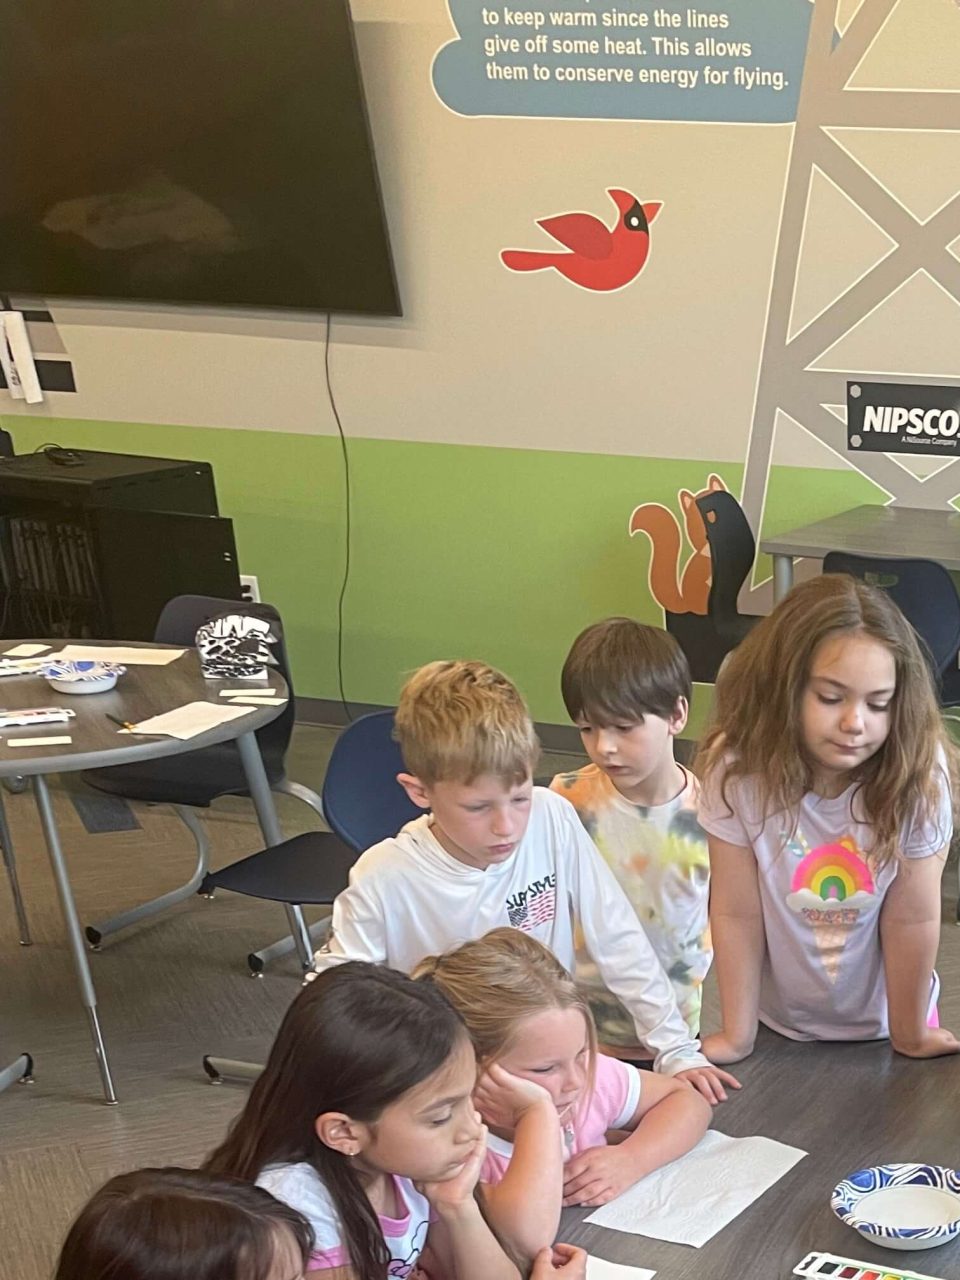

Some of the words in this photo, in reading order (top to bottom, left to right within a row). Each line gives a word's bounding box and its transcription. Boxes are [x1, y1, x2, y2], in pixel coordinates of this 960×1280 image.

[482, 8, 500, 25] to
[504, 8, 545, 30] keep
[549, 12, 597, 27] warm
[602, 9, 649, 27] since
[653, 9, 682, 28] the
[687, 9, 730, 29] lines
[484, 35, 521, 57] give
[525, 35, 548, 53] off
[552, 40, 600, 54] some
[604, 36, 647, 55] heat.
[651, 37, 690, 56] This
[695, 38, 752, 57] allows
[487, 62, 529, 81] them
[533, 64, 550, 81] to
[555, 68, 634, 83] conserve
[639, 69, 699, 89] energy
[704, 66, 730, 85] for
[734, 67, 789, 91] flying.
